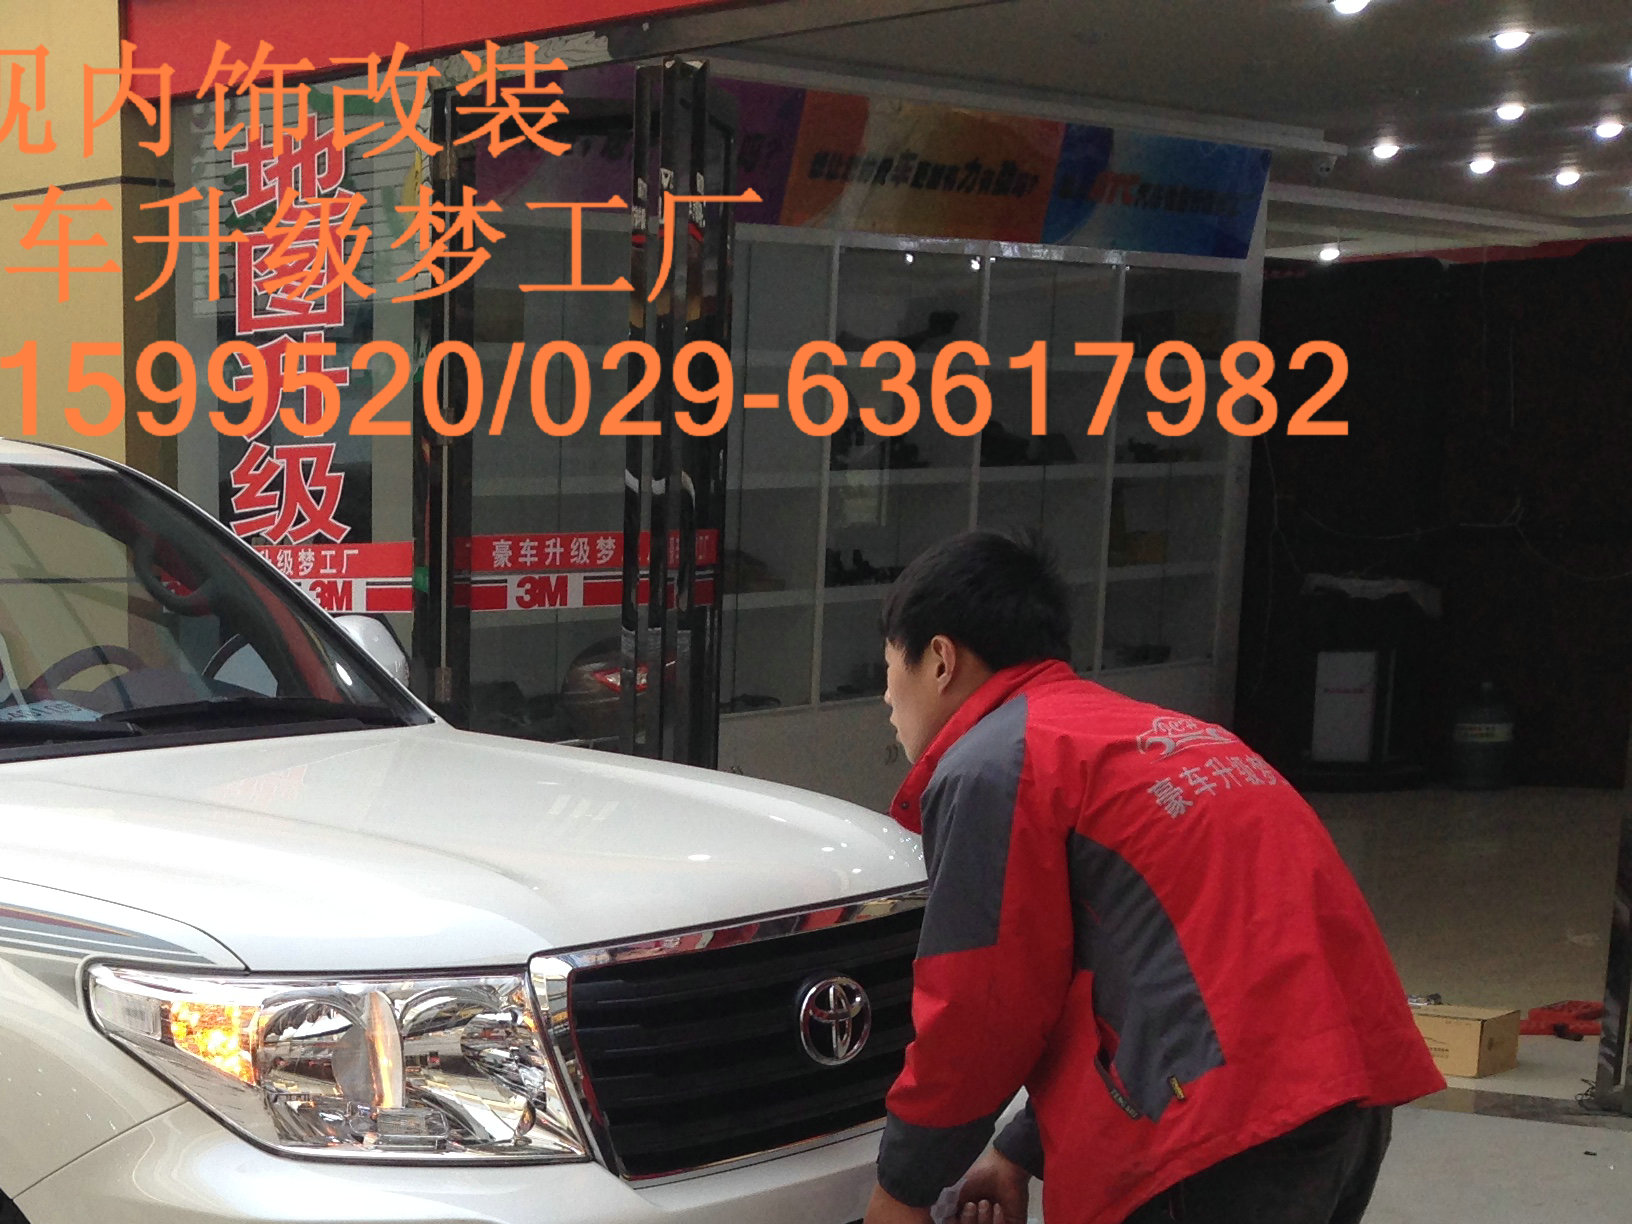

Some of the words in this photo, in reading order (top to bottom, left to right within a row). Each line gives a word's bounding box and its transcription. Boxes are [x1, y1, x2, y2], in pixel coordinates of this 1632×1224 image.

[230, 113, 353, 543] 地图升级
[492, 536, 650, 569] 豪车升级梦
[309, 579, 352, 611] 3M
[515, 575, 568, 609] 3M
[1147, 754, 1282, 819] 豪车升级梦
